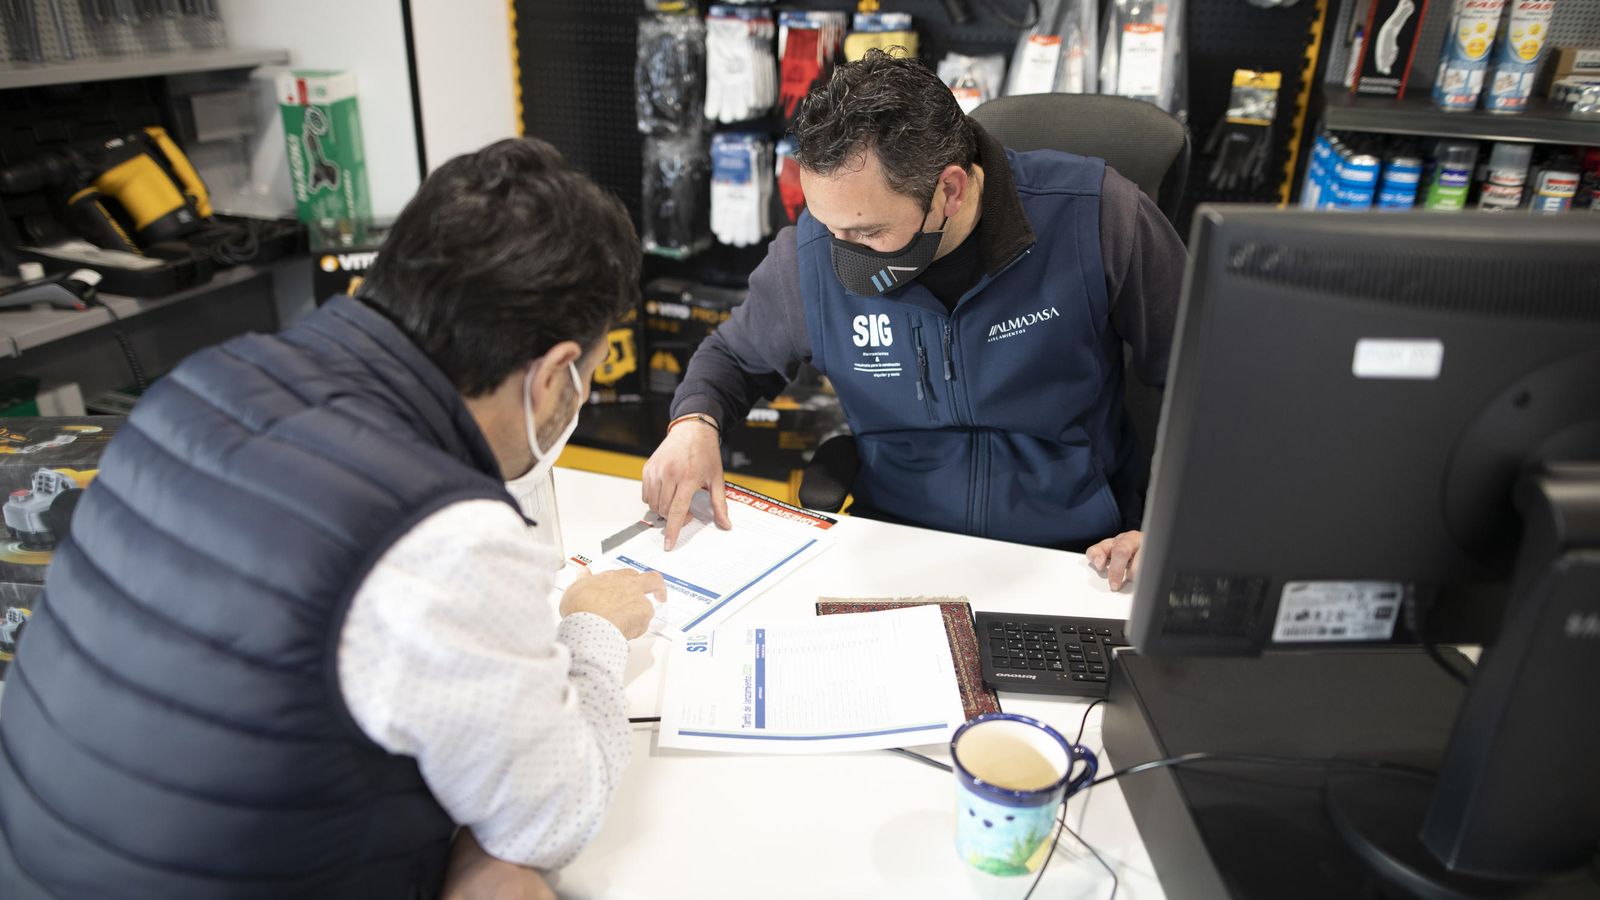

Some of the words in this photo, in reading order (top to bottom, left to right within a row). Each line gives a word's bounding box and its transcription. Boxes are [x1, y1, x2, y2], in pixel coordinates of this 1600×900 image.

[852, 313, 893, 348] SIG
[725, 489, 753, 504] ESPU
[751, 501, 769, 510] EN
[767, 506, 820, 526] ADHESIVO
[995, 672, 1037, 680] lenovo
